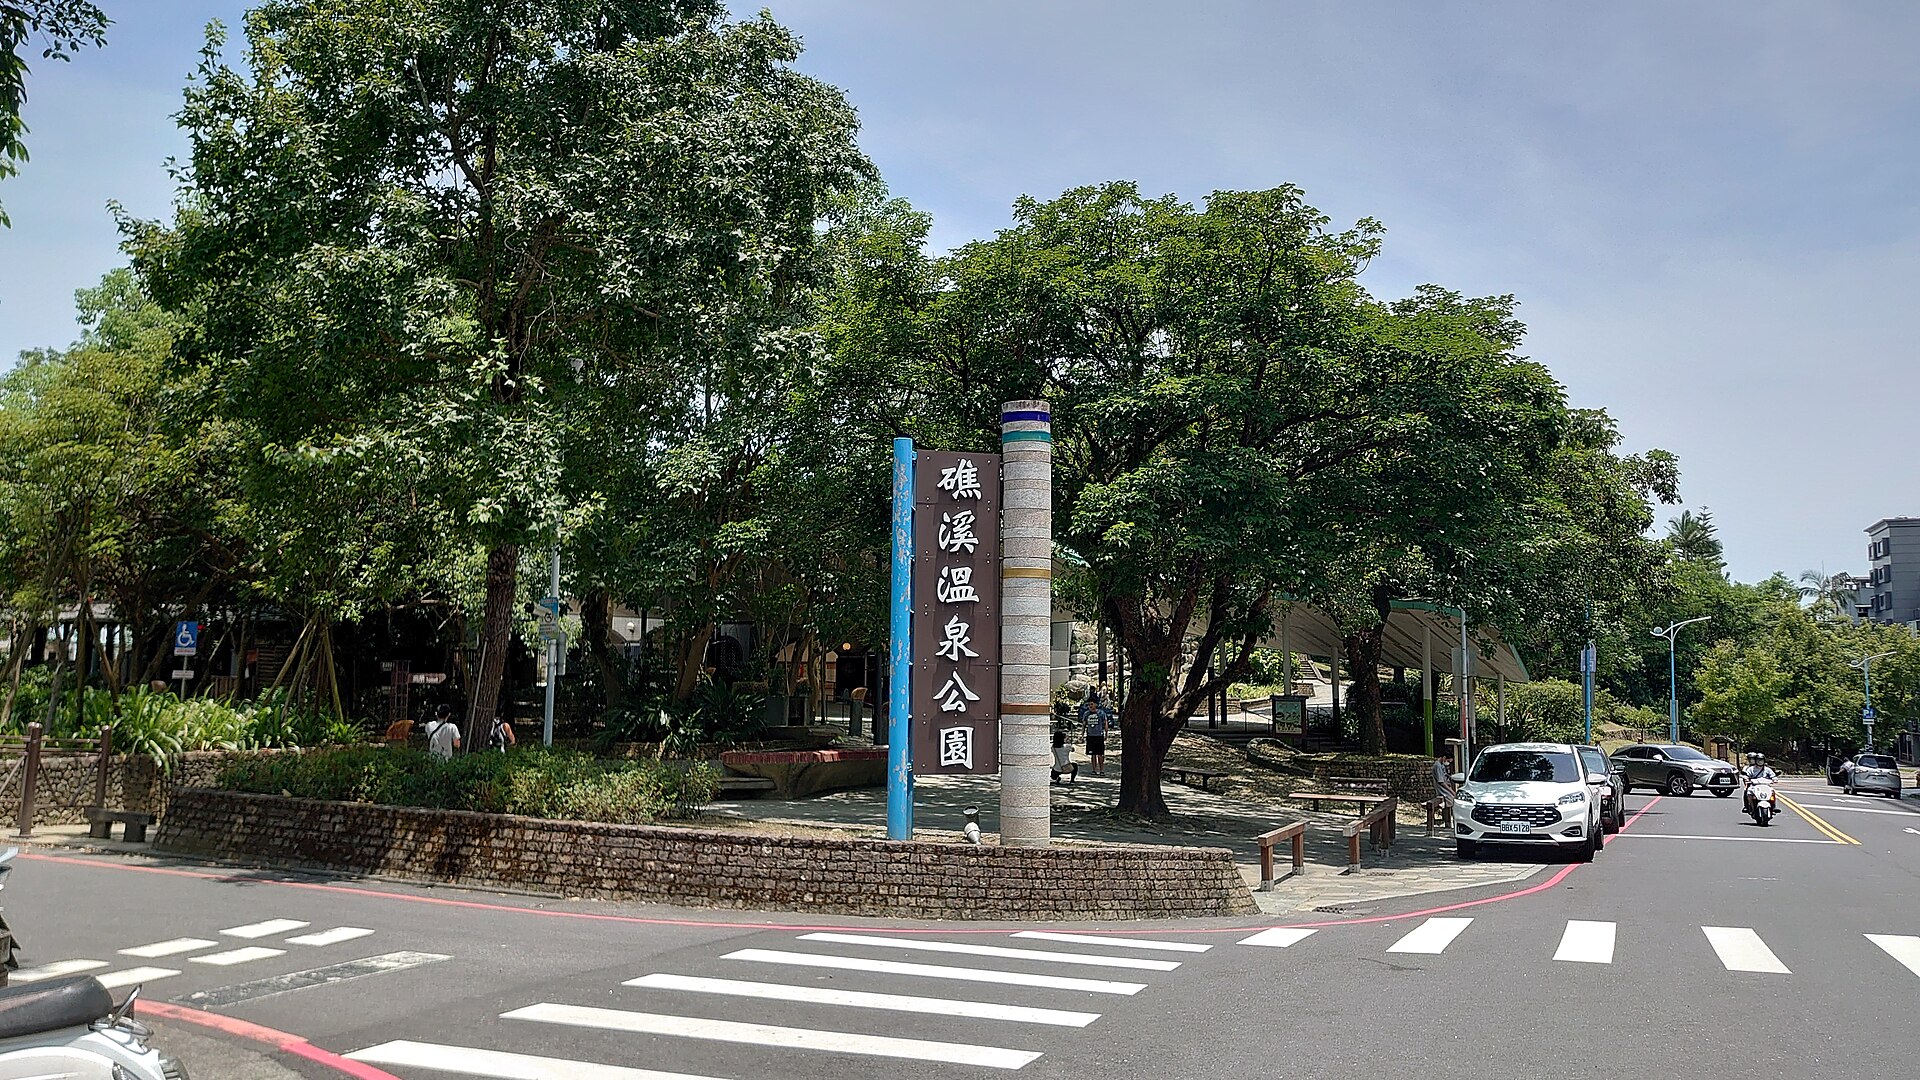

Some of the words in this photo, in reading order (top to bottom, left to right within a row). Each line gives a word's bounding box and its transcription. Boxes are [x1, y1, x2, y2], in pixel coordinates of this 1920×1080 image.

[933, 458, 982, 769] 礁溪溫泉公園
